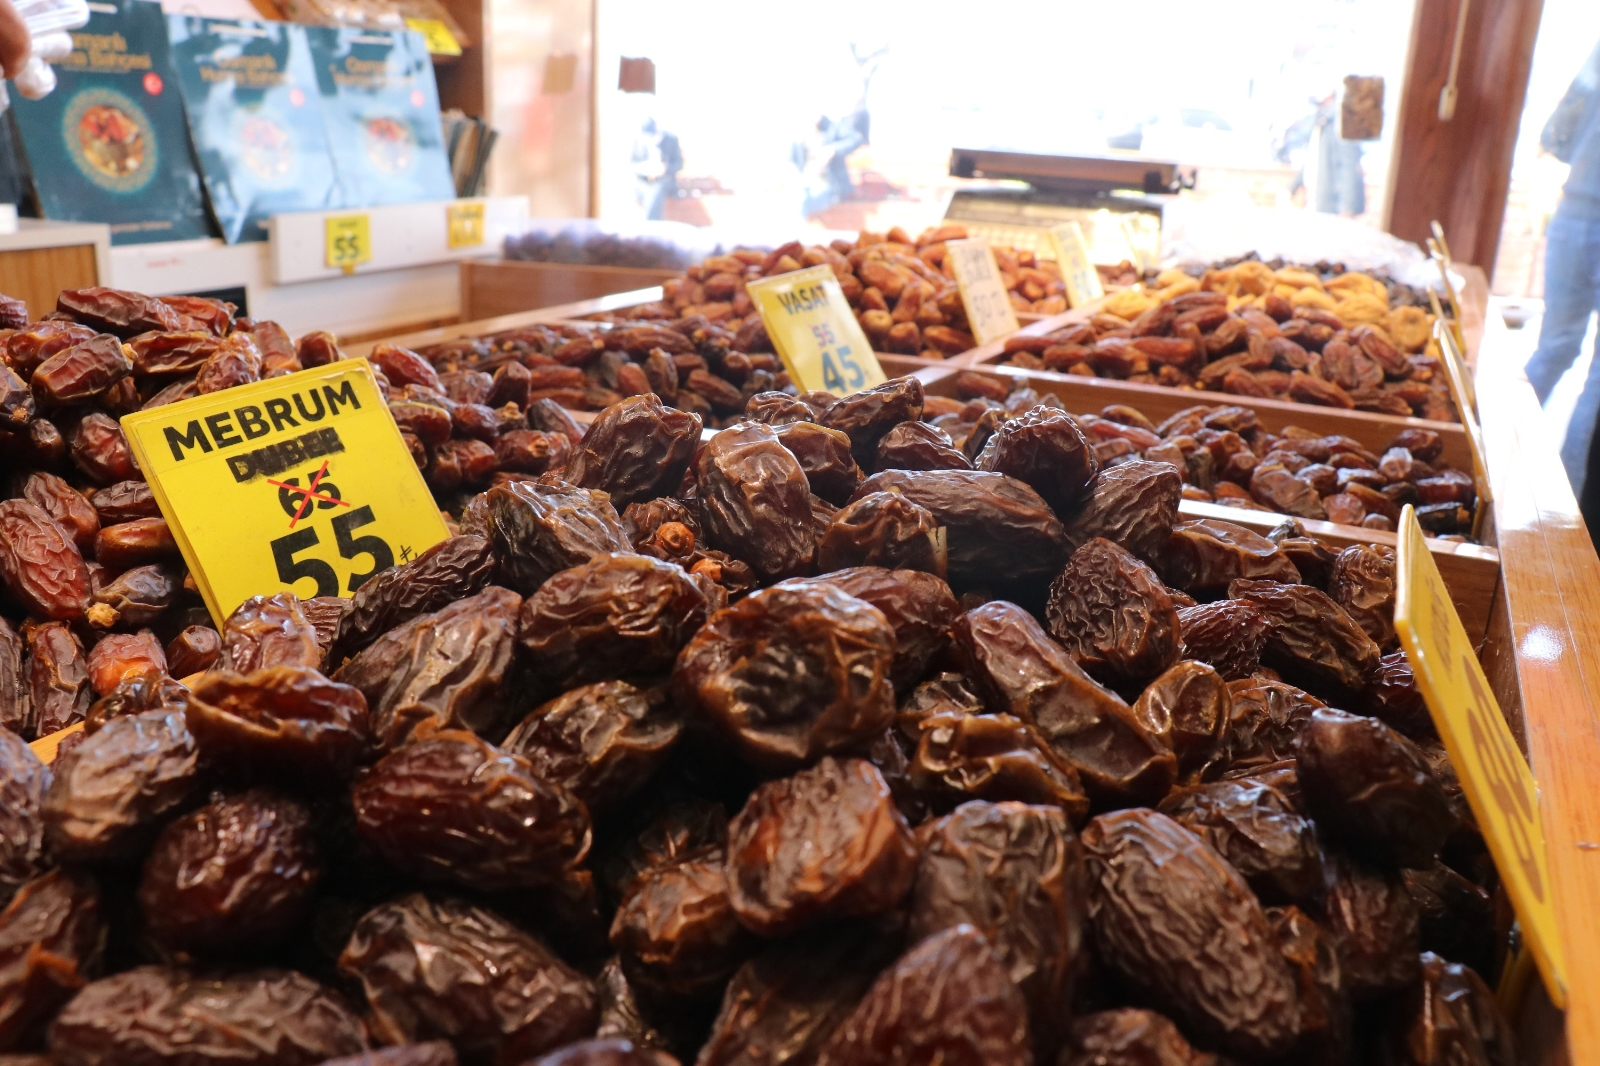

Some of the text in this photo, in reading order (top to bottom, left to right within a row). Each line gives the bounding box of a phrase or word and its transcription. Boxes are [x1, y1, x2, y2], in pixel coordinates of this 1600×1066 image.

[776, 284, 830, 315] VASAT
[821, 345, 865, 393] 45
[162, 380, 362, 462] MEBRUM
[278, 468, 342, 520] 65
